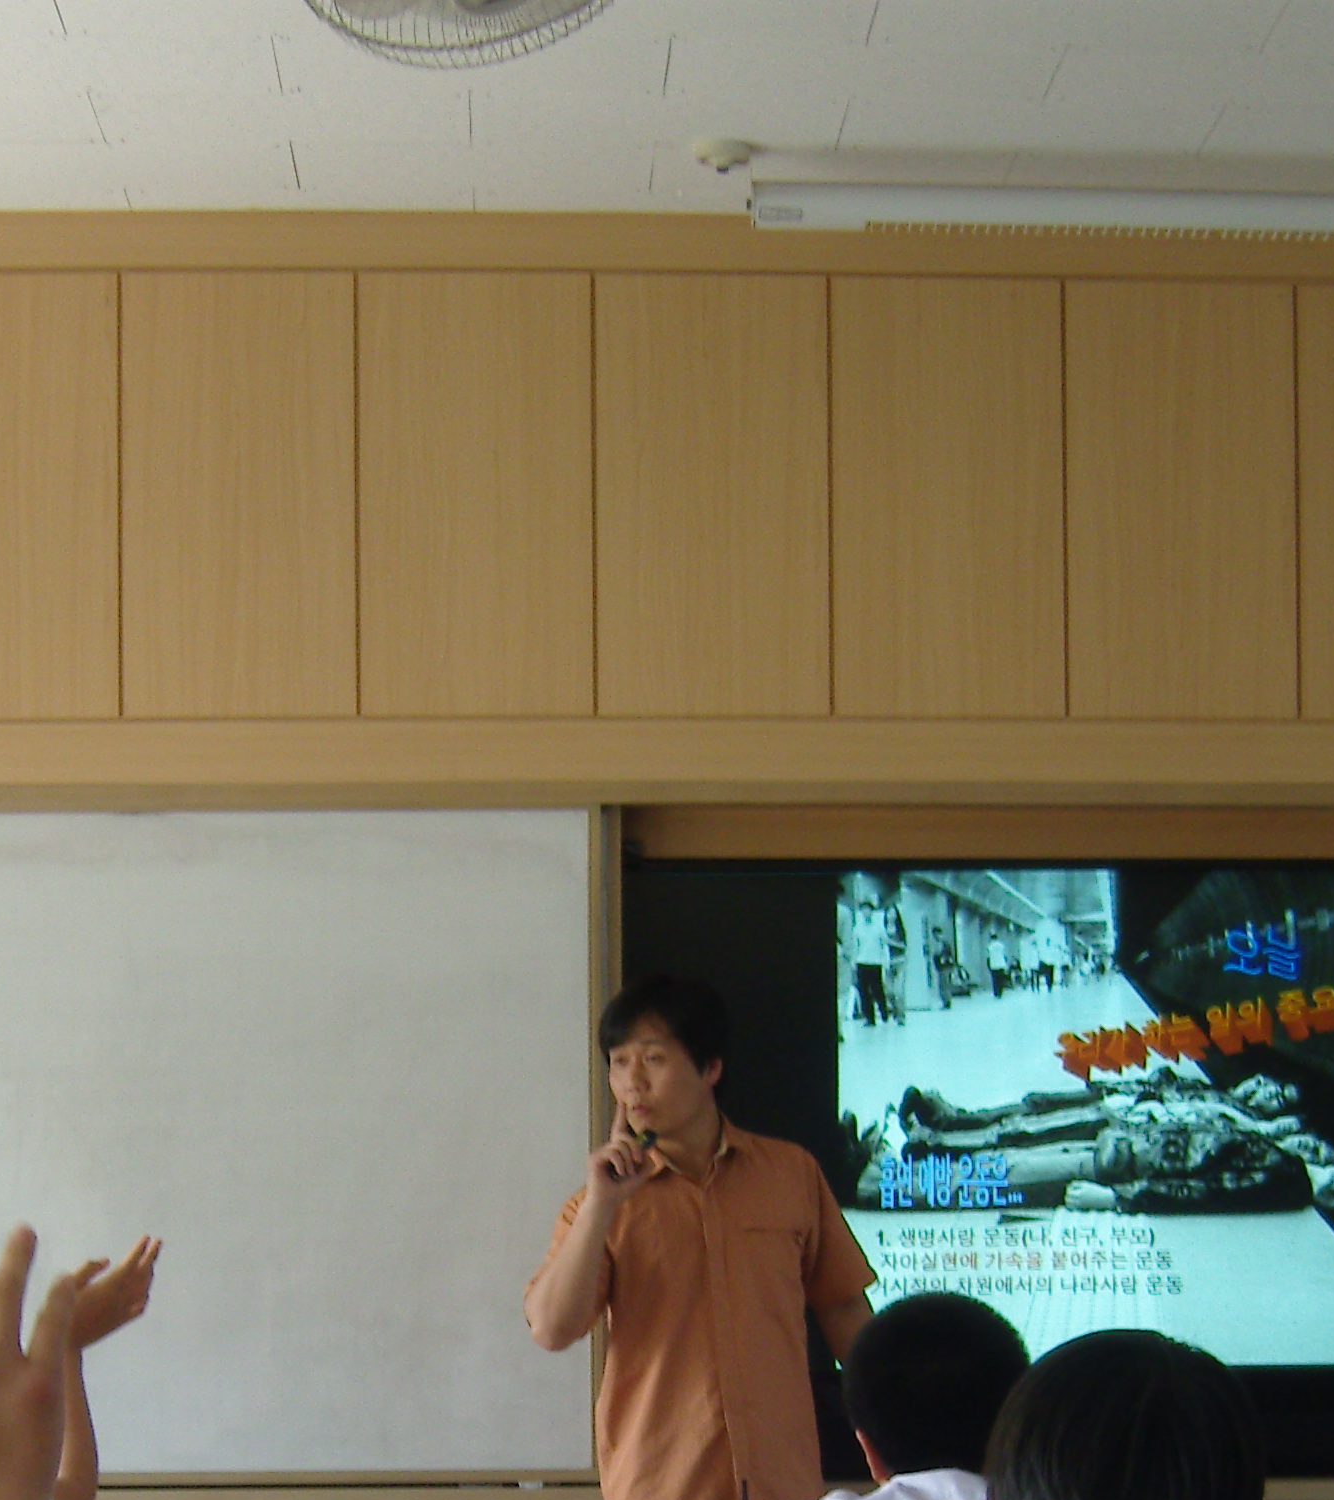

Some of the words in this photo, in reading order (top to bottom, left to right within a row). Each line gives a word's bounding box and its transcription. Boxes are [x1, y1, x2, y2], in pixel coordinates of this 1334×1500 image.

[878, 1154, 914, 1209] 흡연
[918, 1152, 953, 1208] 예방
[877, 1229, 891, 1247] 1.
[899, 1227, 975, 1248] 생명사랑
[1110, 1226, 1156, 1248] 부모)
[880, 1251, 978, 1272] 자아실현에
[1137, 1250, 1173, 1271] 운동
[1060, 1273, 1137, 1296] 나라사랑
[1147, 1274, 1184, 1296] 운동
